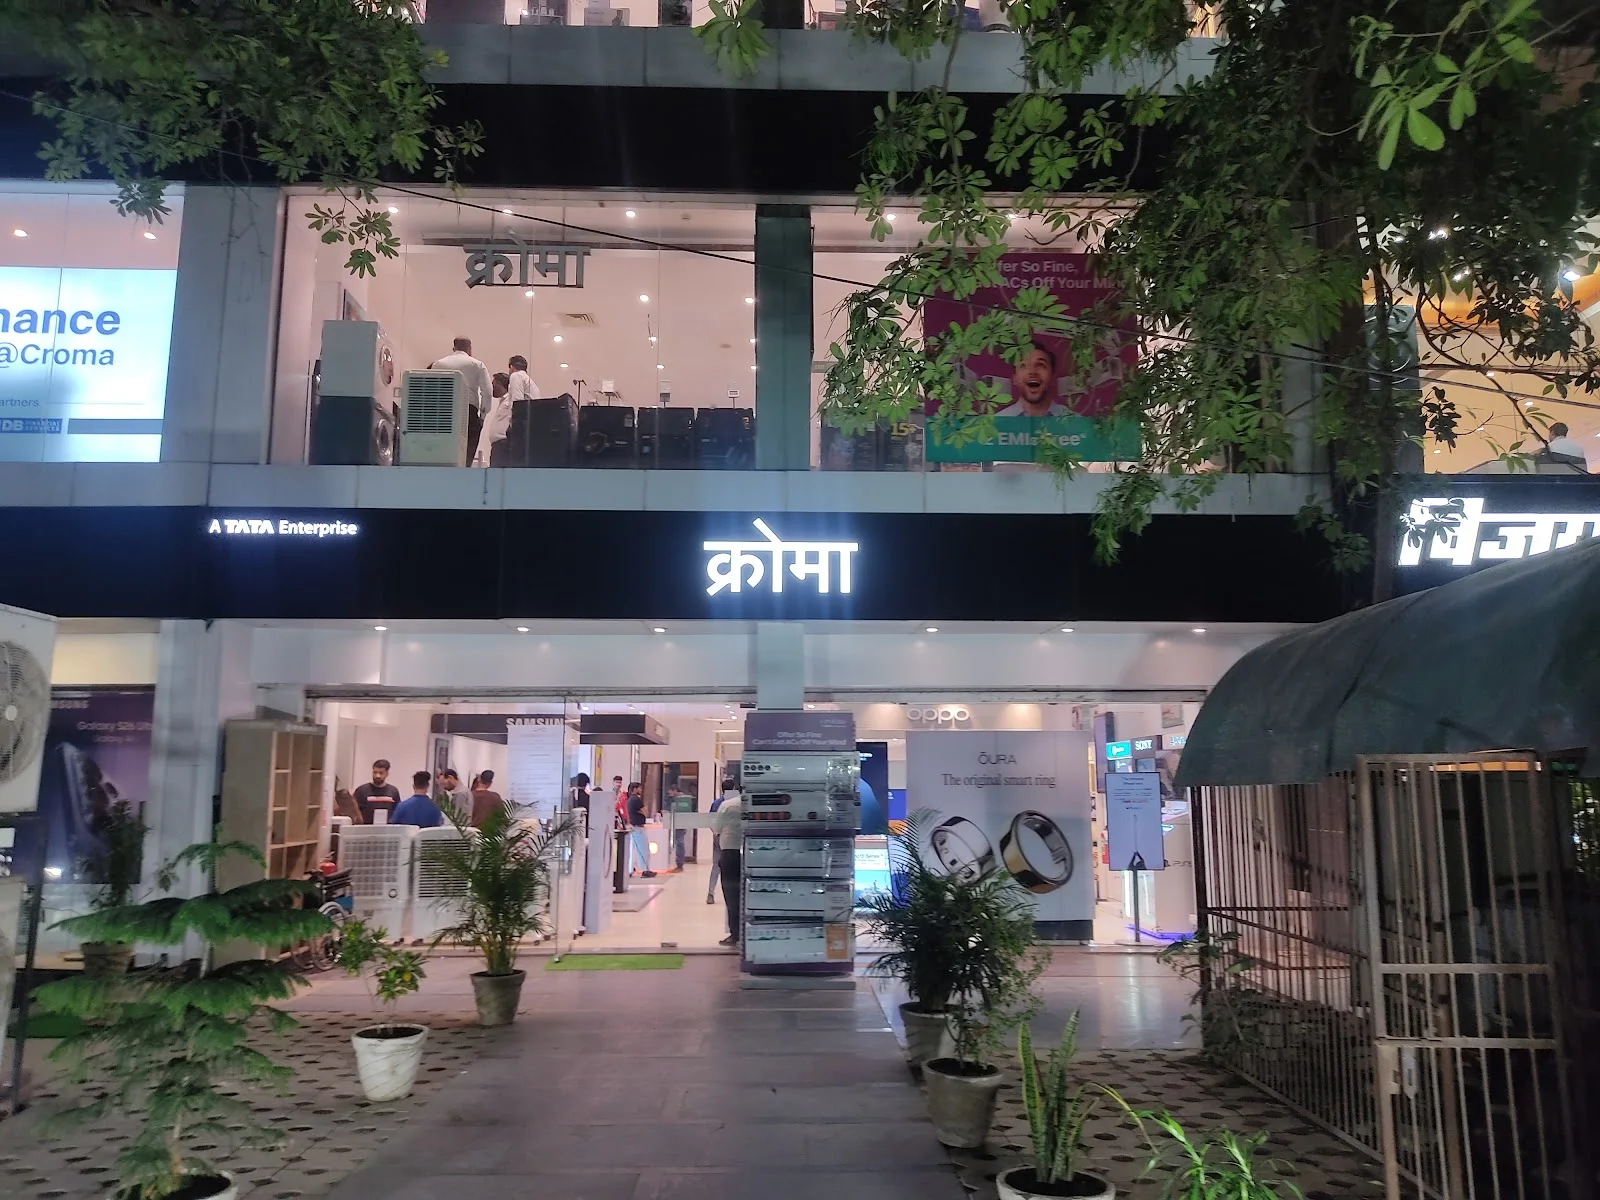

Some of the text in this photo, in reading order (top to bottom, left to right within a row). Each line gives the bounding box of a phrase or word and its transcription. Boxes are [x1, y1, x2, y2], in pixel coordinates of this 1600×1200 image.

[462, 226, 591, 289] क्रोमा
[1021, 260, 1040, 272] So
[1043, 260, 1078, 273] Fine,
[1032, 276, 1055, 289] Off
[1059, 277, 1091, 289] Your
[0, 342, 114, 368] @Croma
[209, 519, 358, 537] A TATA Enterprise
[703, 517, 859, 596] क्रोमा
[907, 707, 970, 724] oppo
[1135, 739, 1153, 750] SONY
[942, 773, 1056, 788] The original smart ring
